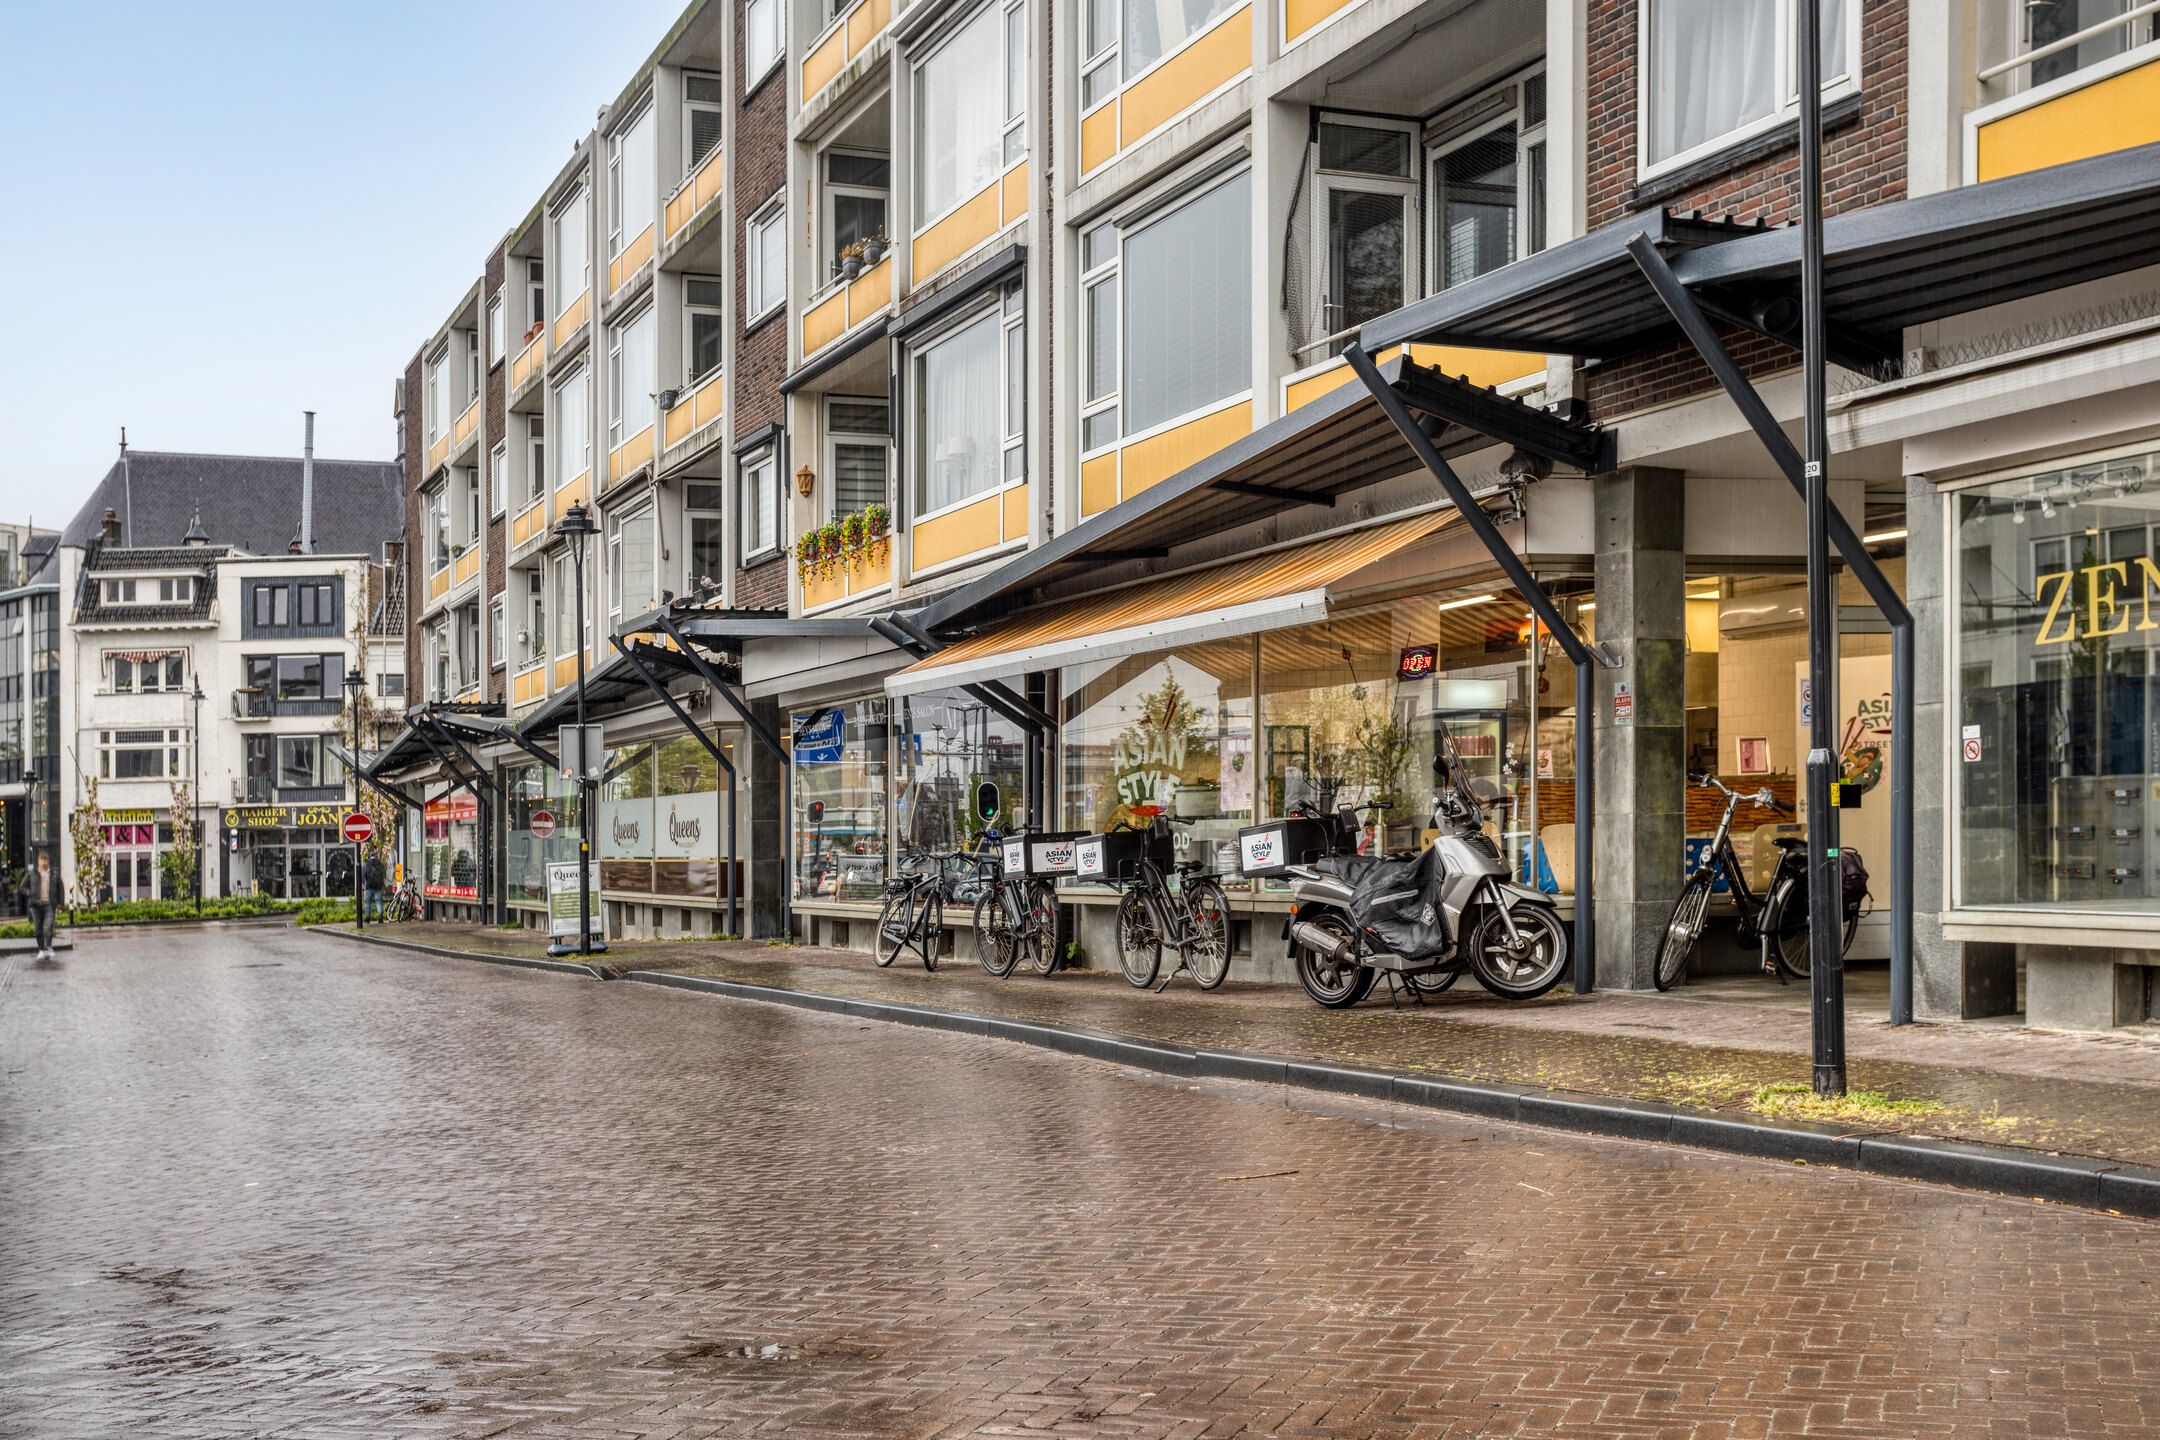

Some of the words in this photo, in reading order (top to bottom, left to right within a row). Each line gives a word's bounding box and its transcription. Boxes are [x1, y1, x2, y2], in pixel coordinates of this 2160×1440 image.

[1807, 465, 1817, 473] 20
[1403, 656, 1432, 671] OPEN
[1857, 699, 1892, 717] ASI
[1861, 714, 1892, 729] STY
[1114, 732, 1187, 776] ASIAN
[1117, 770, 1181, 805] STYLE
[241, 807, 287, 817] BARBER
[247, 817, 278, 827] SHOP
[669, 812, 701, 846] Queens
[137, 824, 151, 843] N
[613, 815, 640, 847] Queens
[1173, 832, 1190, 850] OD
[1251, 842, 1273, 854] ASIAN
[1045, 849, 1073, 859] ASIAN
[1047, 856, 1071, 864] STYLE
[1082, 851, 1097, 861] ASIAN
[1252, 850, 1271, 860] STYLE
[553, 868, 593, 881] Quees
